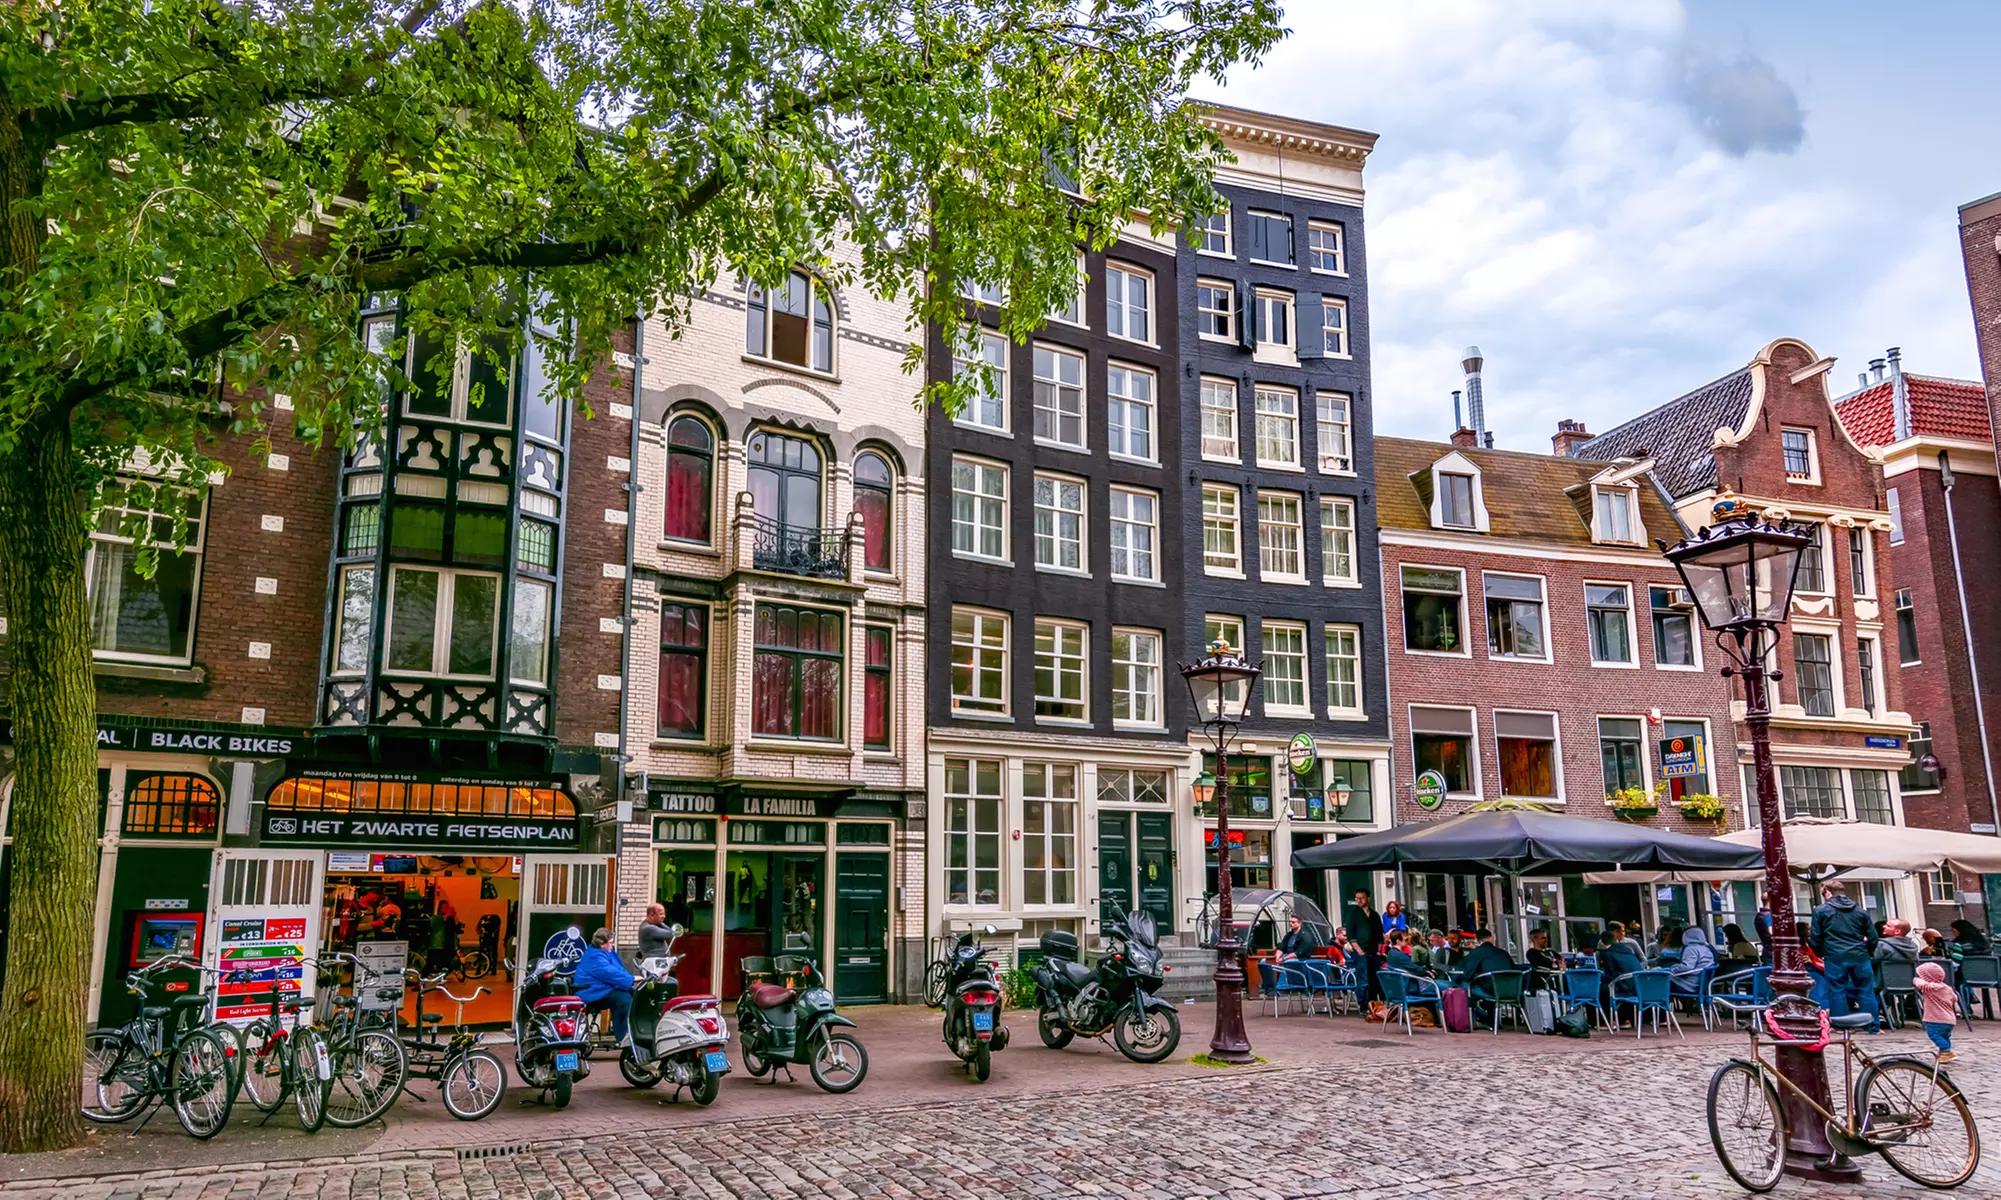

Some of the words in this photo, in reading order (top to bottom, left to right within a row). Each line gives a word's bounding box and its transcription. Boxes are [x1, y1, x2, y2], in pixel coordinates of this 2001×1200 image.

[151, 732, 223, 750] BLACK
[228, 737, 292, 754] BIKES
[1667, 764, 1693, 774] ATM
[303, 770, 337, 778] maandag
[353, 772, 378, 780] vrijdag
[440, 777, 470, 785] zaterdag
[480, 779, 504, 787] zondag
[661, 793, 715, 812] TATTOO
[743, 797, 760, 814] LA
[763, 797, 817, 816] FAMILIA
[302, 820, 344, 835] HET
[351, 821, 439, 837] ZWARTE
[446, 823, 574, 840] FIETSENPLAN
[241, 930, 261, 940] €13
[283, 929, 303, 938] €25
